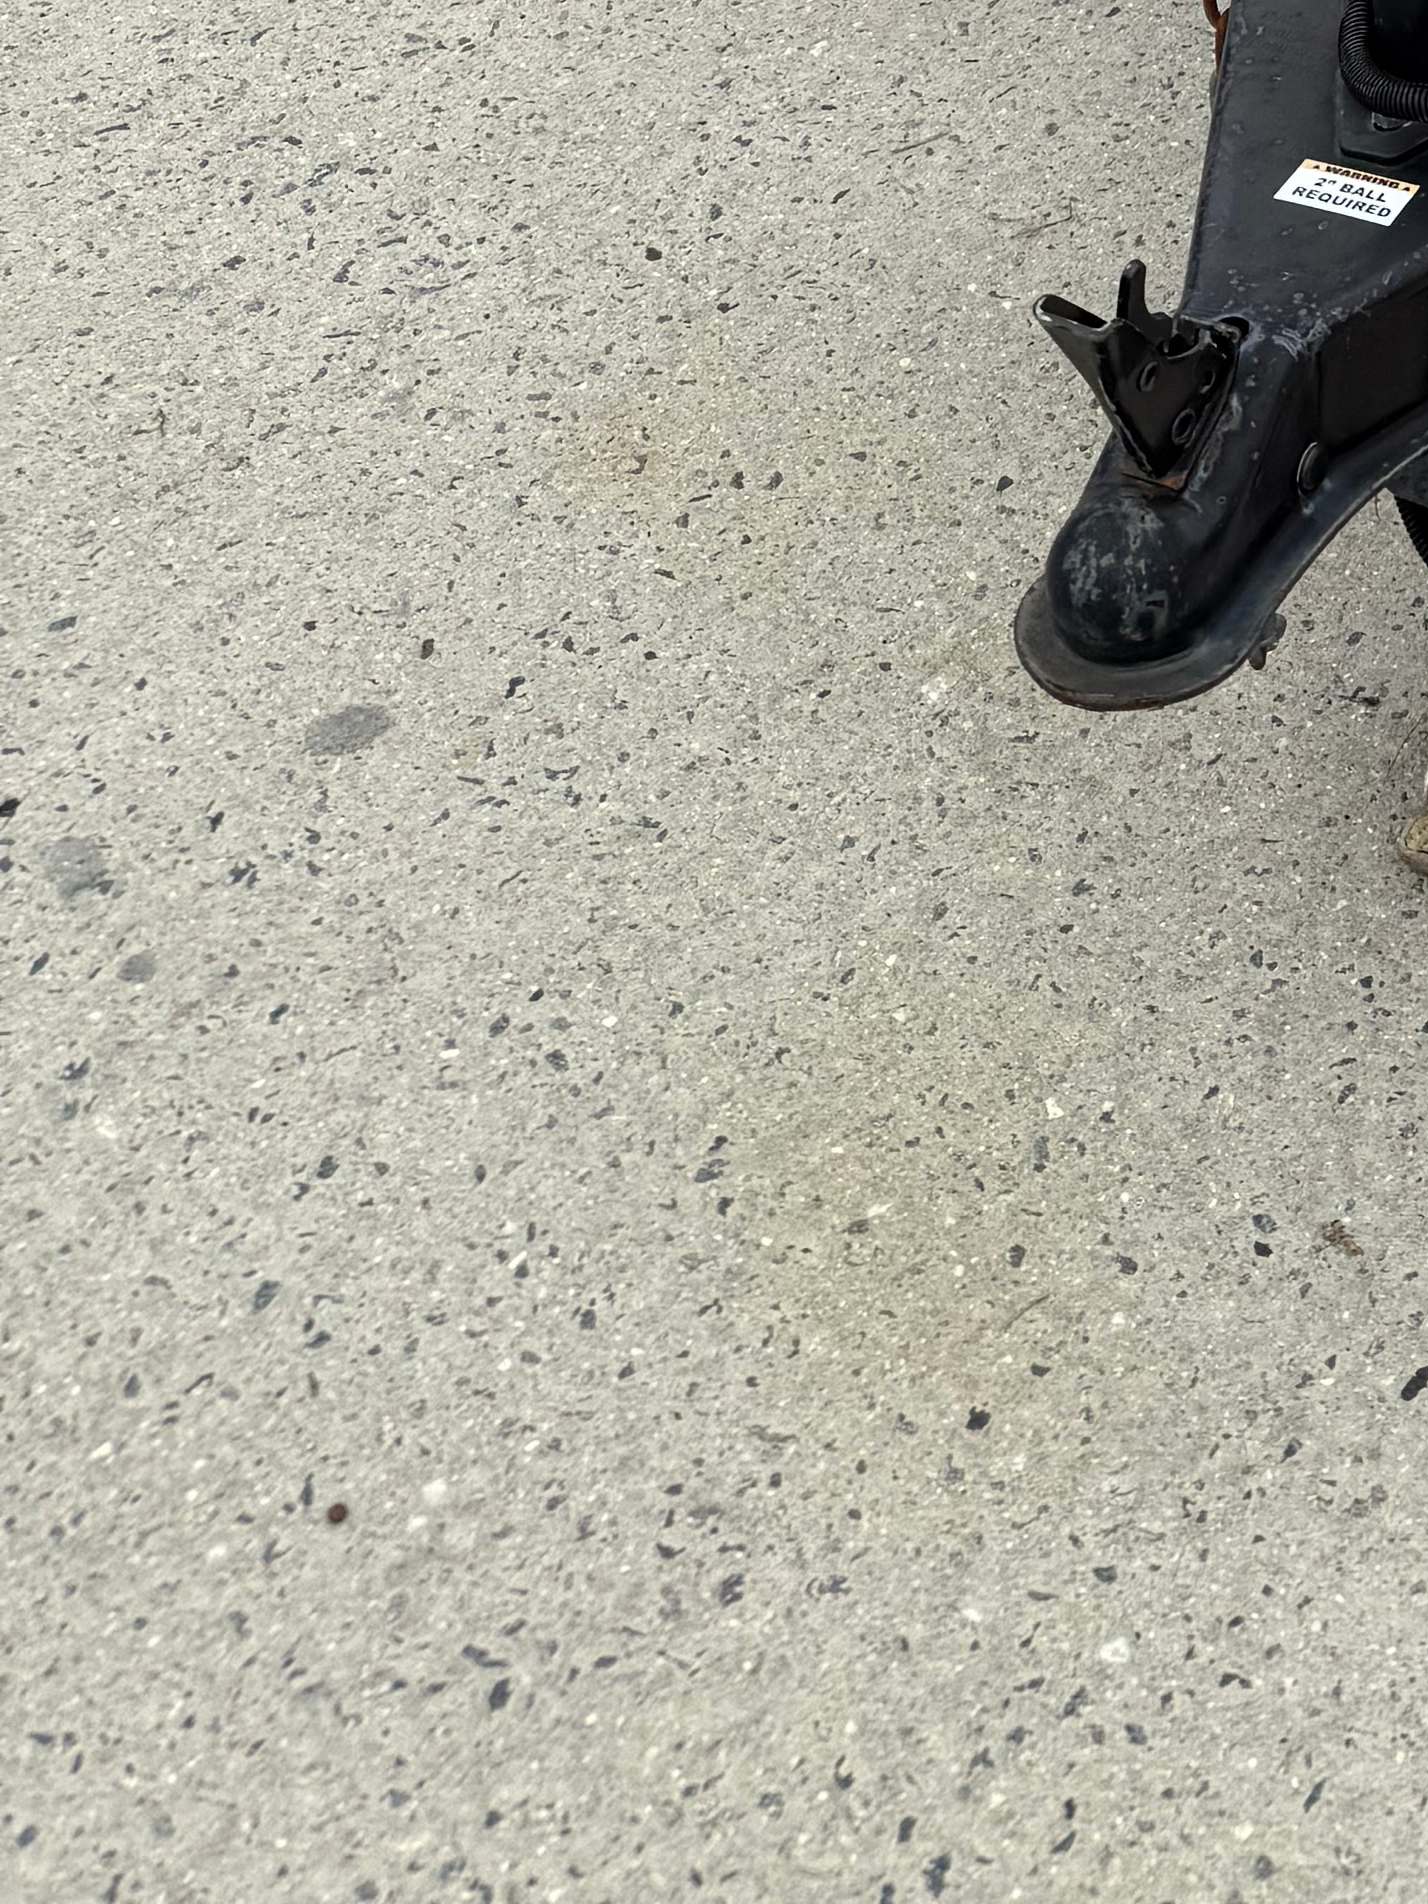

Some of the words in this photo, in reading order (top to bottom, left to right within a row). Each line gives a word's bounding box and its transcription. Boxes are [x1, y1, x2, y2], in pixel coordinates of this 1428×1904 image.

[1314, 177, 1337, 187] 2"
[1339, 183, 1387, 203] BALL
[1324, 165, 1401, 189] WARNING
[1291, 186, 1392, 217] REQUIRED
